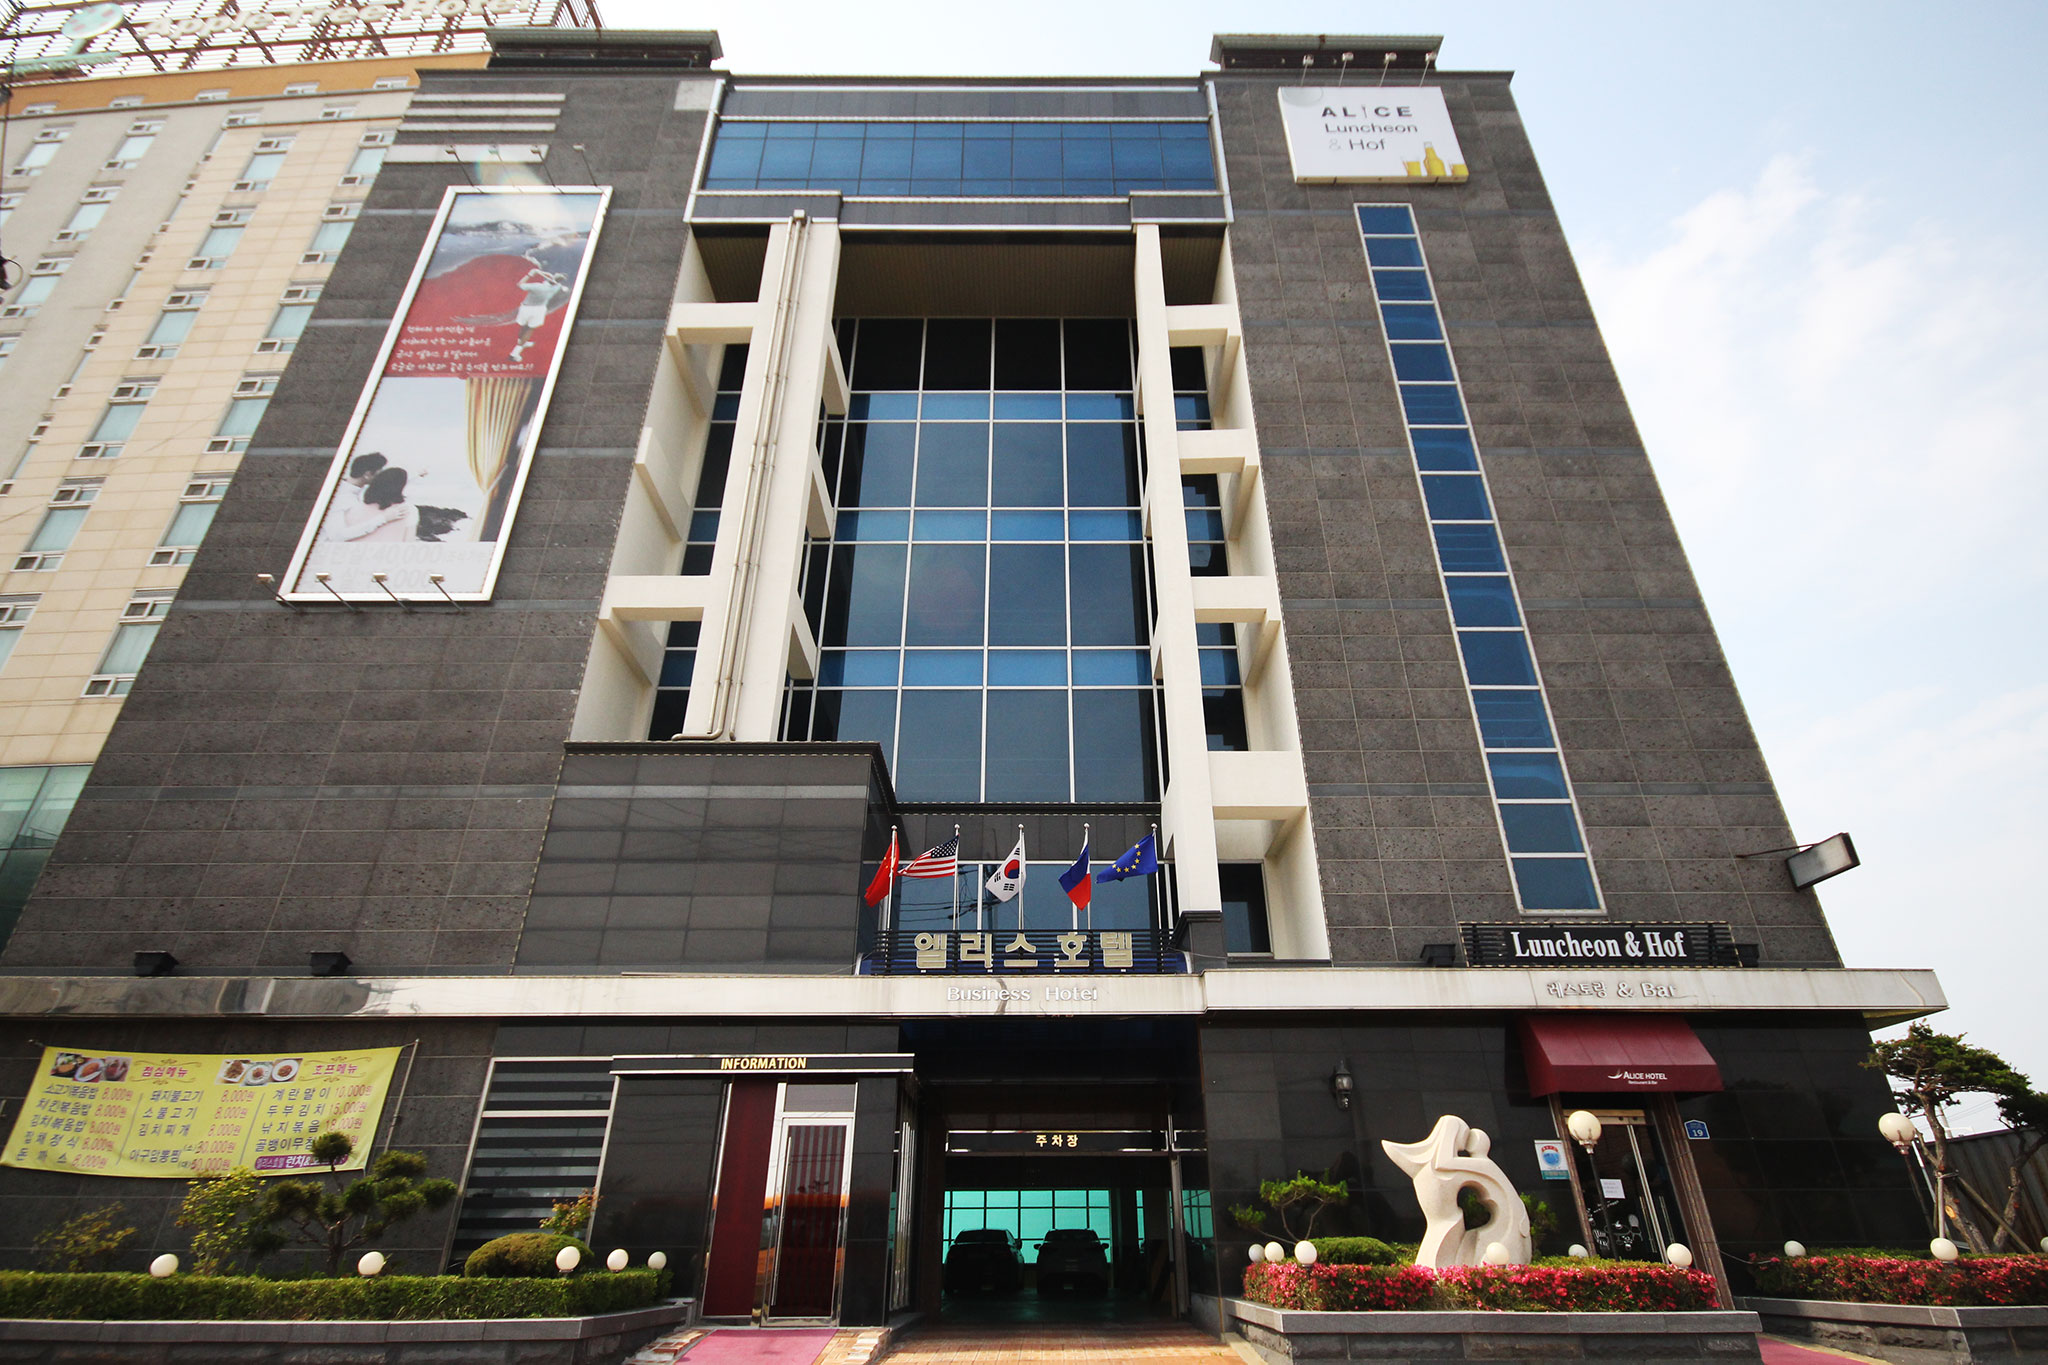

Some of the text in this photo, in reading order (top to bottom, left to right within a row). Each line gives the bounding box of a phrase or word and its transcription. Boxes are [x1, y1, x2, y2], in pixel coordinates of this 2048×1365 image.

[138, 0, 534, 39] Apple Tree Hotel
[1321, 105, 1413, 118] ALICE
[1325, 122, 1418, 133] Luncheon
[1348, 138, 1386, 150] Hof
[1510, 931, 1688, 958] Luncheon & Hof
[947, 986, 1031, 1001] Business
[1547, 982, 1677, 998] 레스토랑 & Bar
[312, 1063, 358, 1076] 호프메뉴
[721, 1057, 807, 1070] INFORMATION
[142, 1066, 189, 1078] 점심메뉴
[1623, 1071, 1645, 1080] ALICE
[150, 1090, 204, 1102] 돼지불고기
[272, 1086, 331, 1101] 계란말이
[37, 1098, 92, 1116] 치킨볶음밥
[142, 1106, 198, 1119] 소불고기
[267, 1103, 327, 1118] 두부김치
[138, 1123, 191, 1137] 김치찌개
[1693, 1129, 1704, 1137] 19
[1035, 1134, 1079, 1148] 주차장
